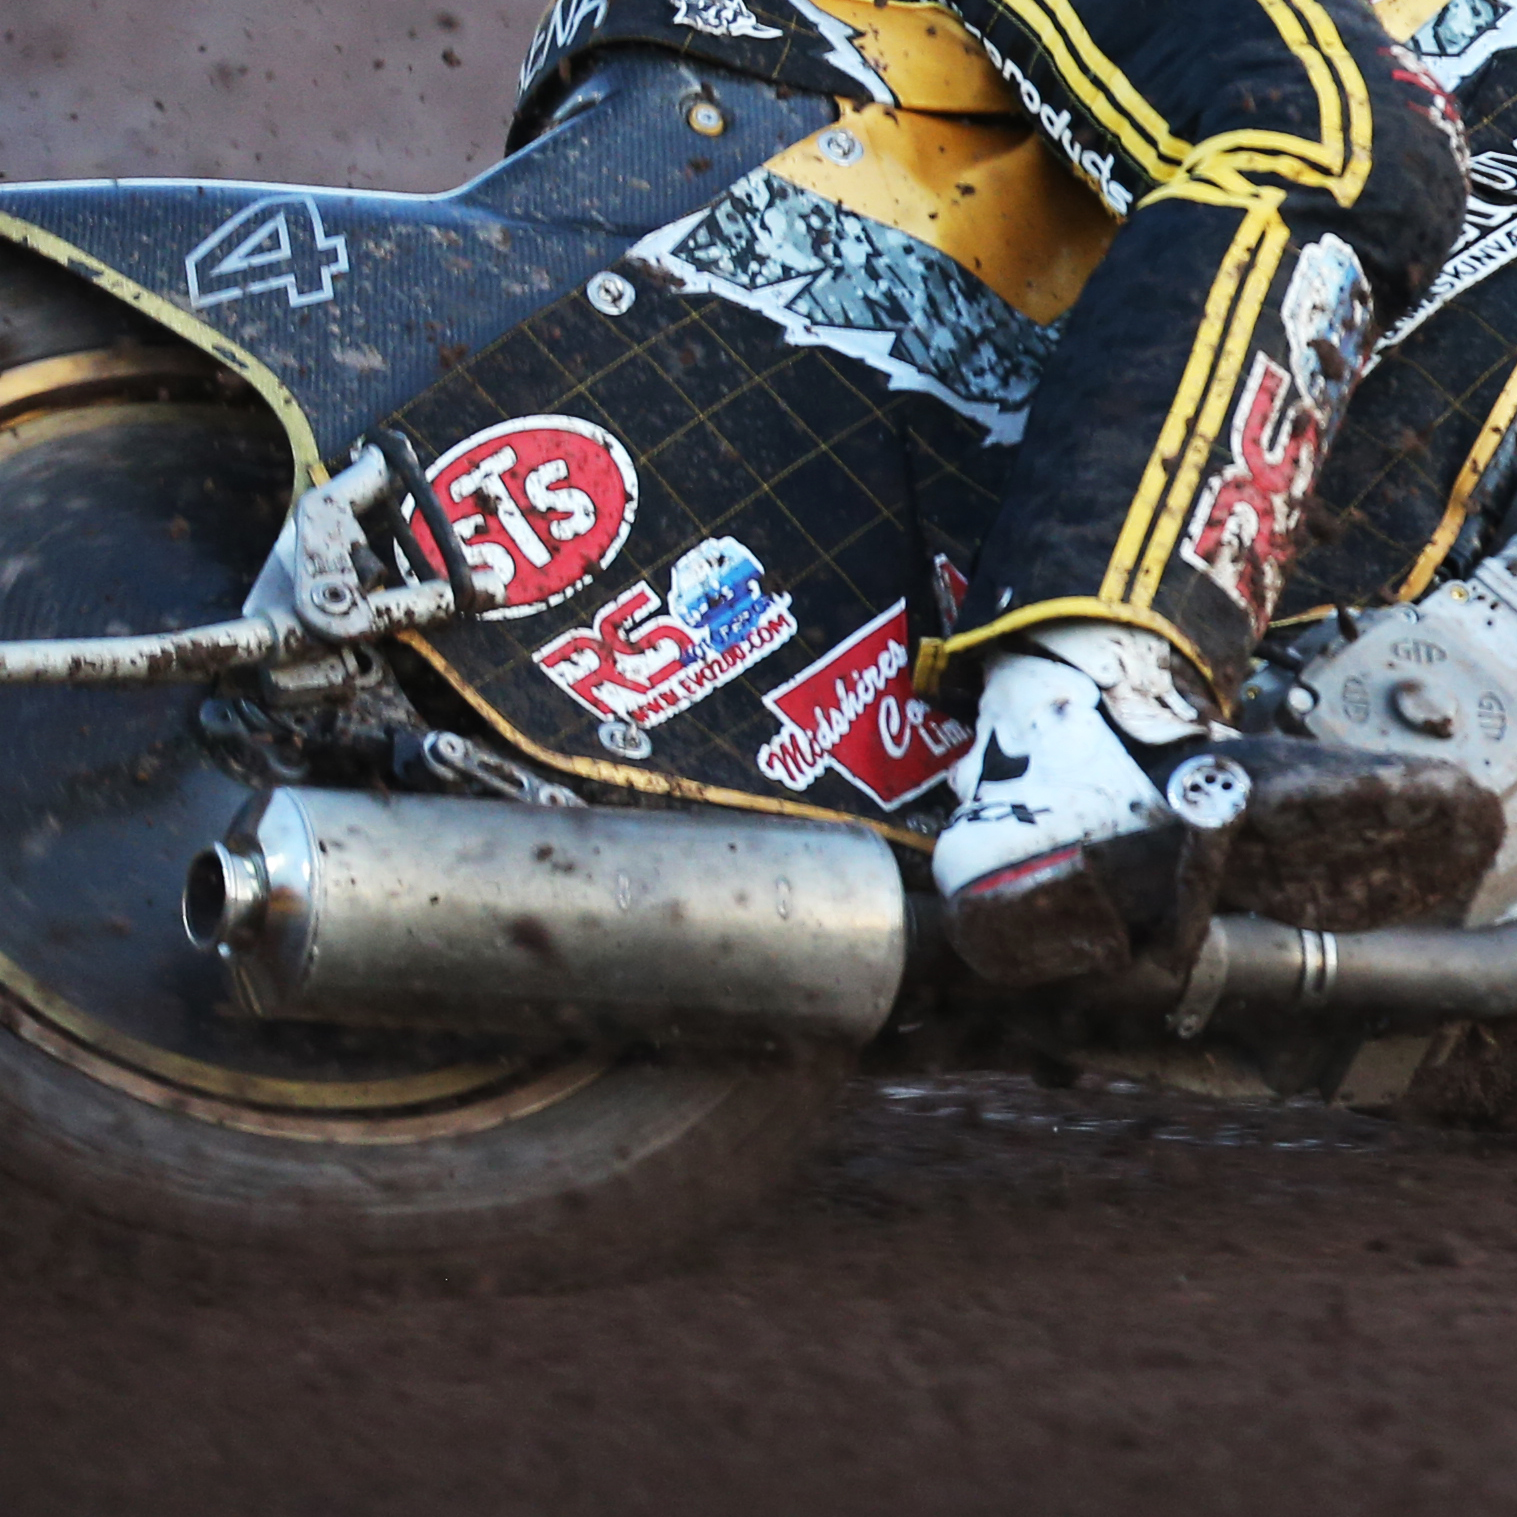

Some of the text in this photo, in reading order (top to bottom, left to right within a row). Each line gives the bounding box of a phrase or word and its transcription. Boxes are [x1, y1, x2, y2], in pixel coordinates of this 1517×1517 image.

[186, 194, 349, 309] 4
[450, 445, 597, 589] STS
[536, 586, 695, 718] RS
[765, 638, 908, 783] Midshires
